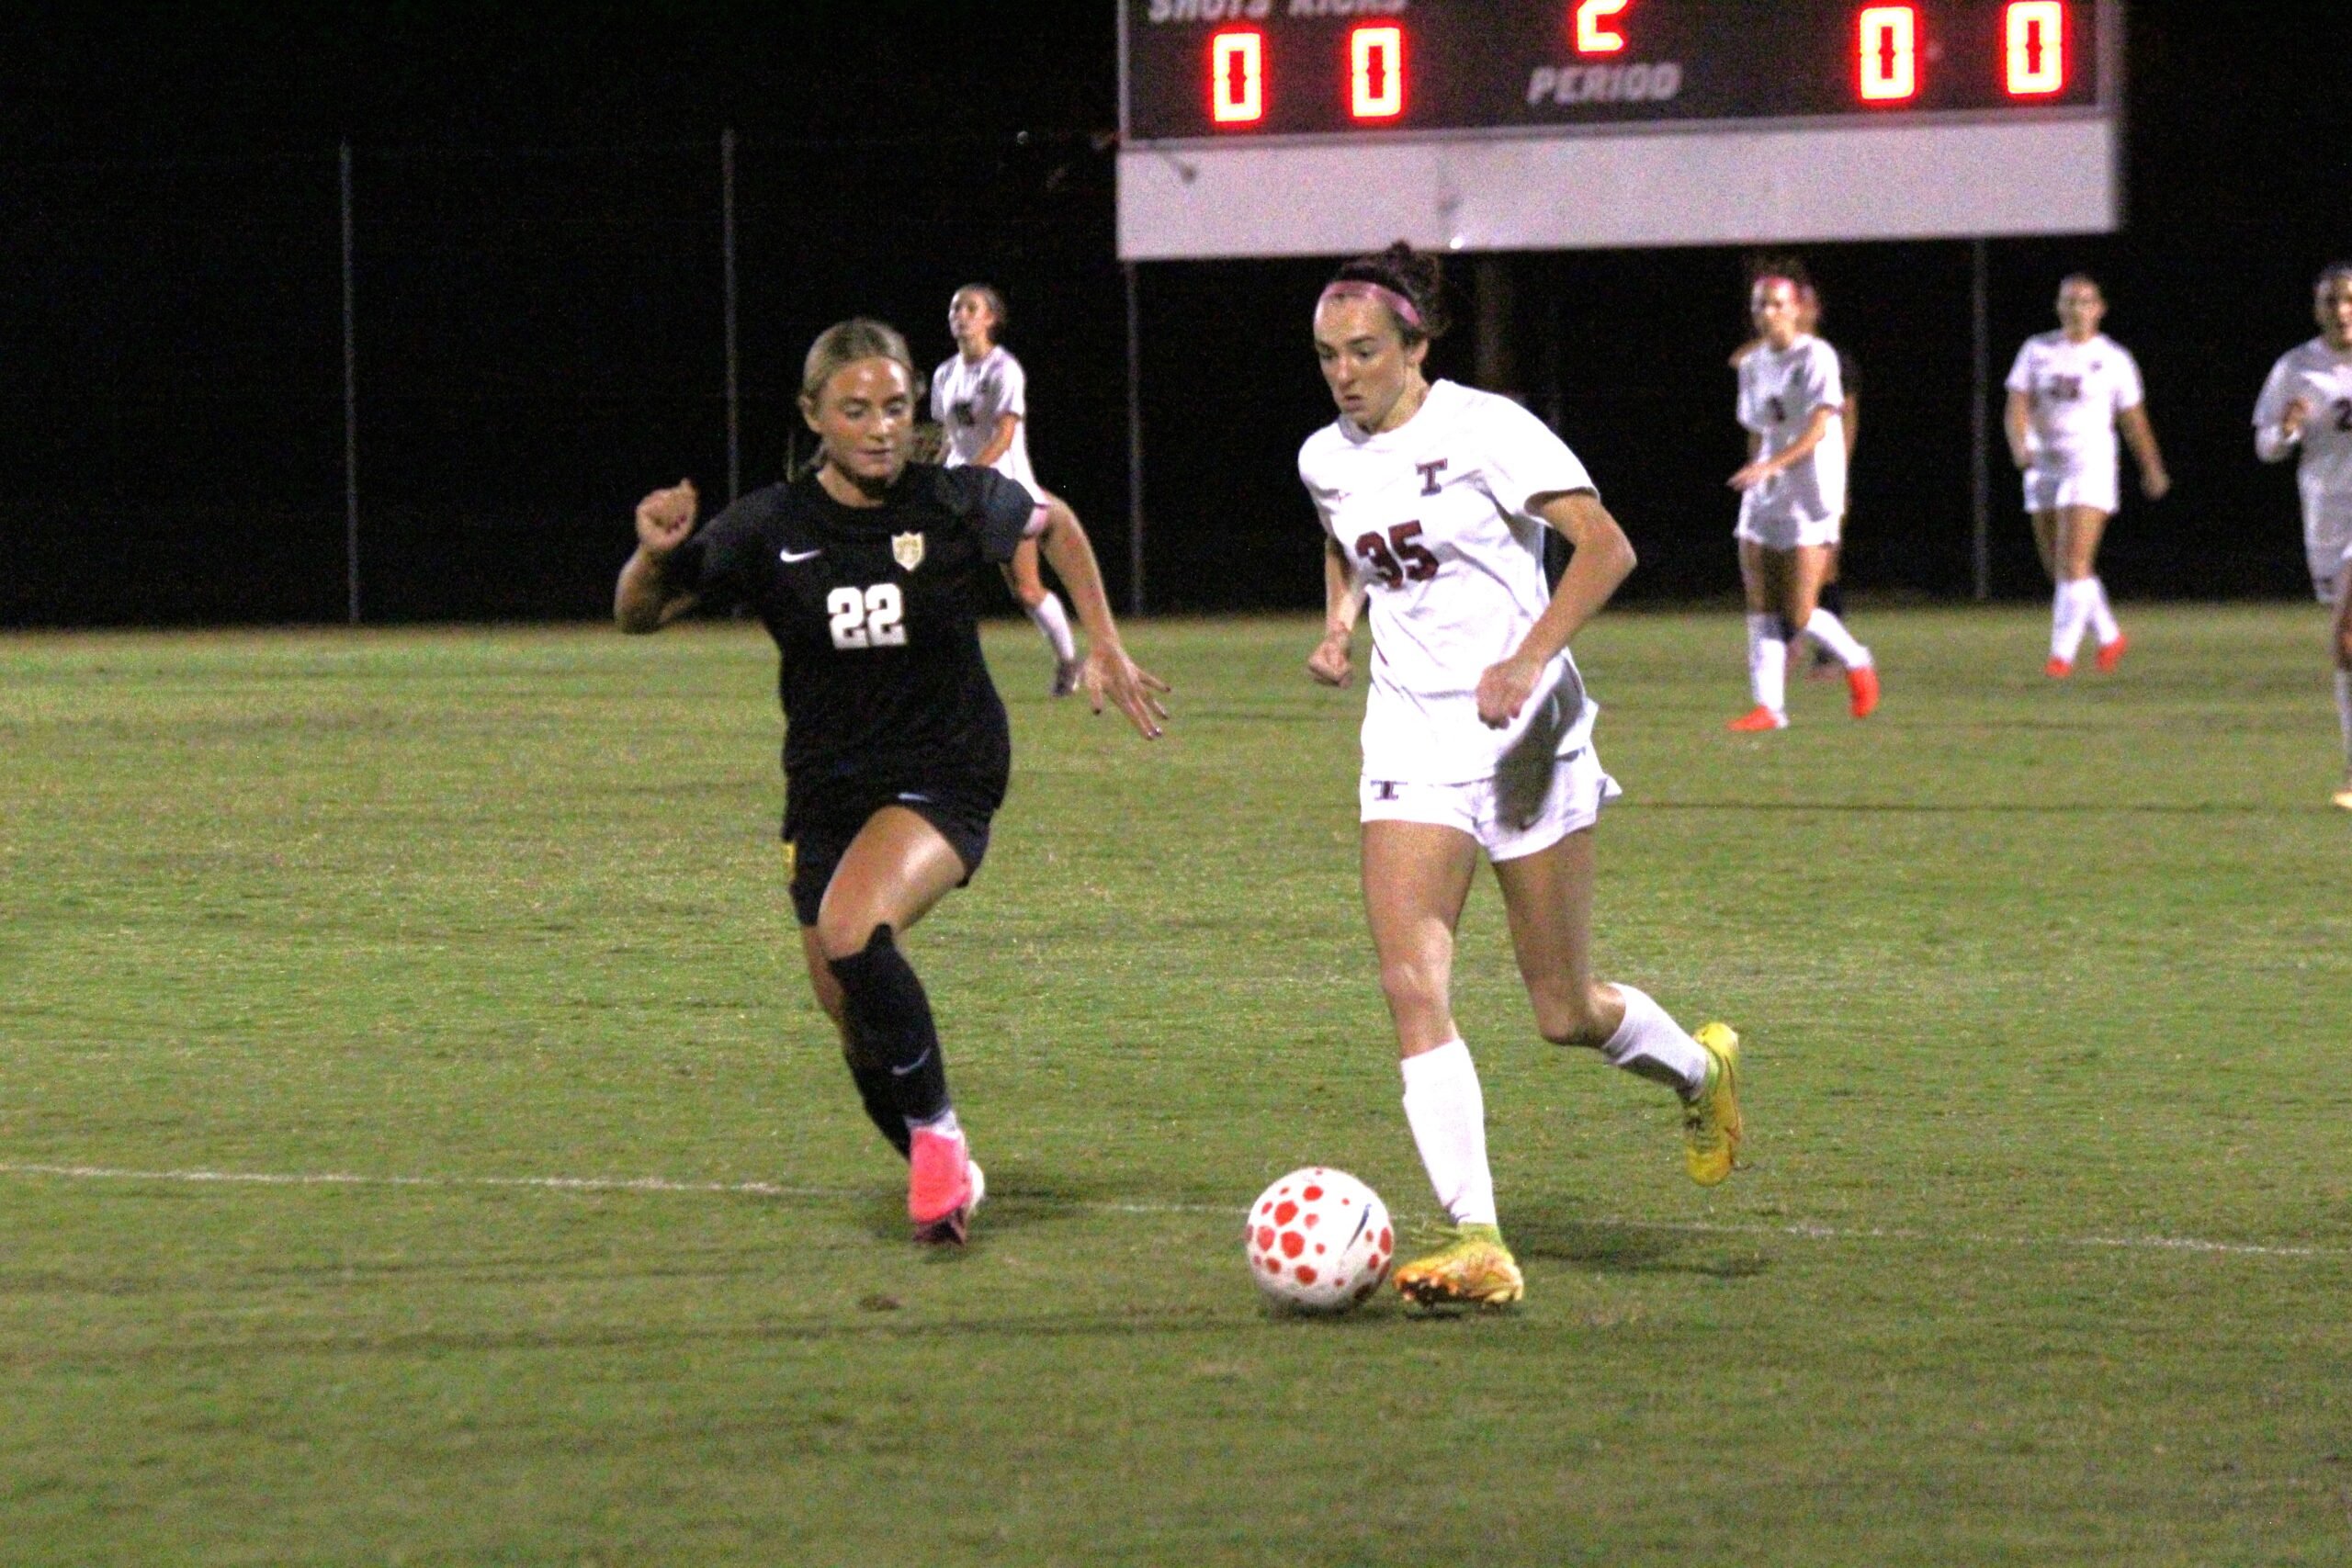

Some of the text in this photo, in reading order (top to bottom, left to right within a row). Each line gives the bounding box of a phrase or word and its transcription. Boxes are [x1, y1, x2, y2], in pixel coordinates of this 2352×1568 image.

[1577, 0, 1629, 52] 2
[1860, 6, 1915, 100] 0
[2007, 1, 2063, 95] 0
[1213, 33, 1262, 122] 0
[1351, 28, 1402, 118] 0
[1527, 62, 1683, 105] PERIOD
[827, 582, 908, 650] 22
